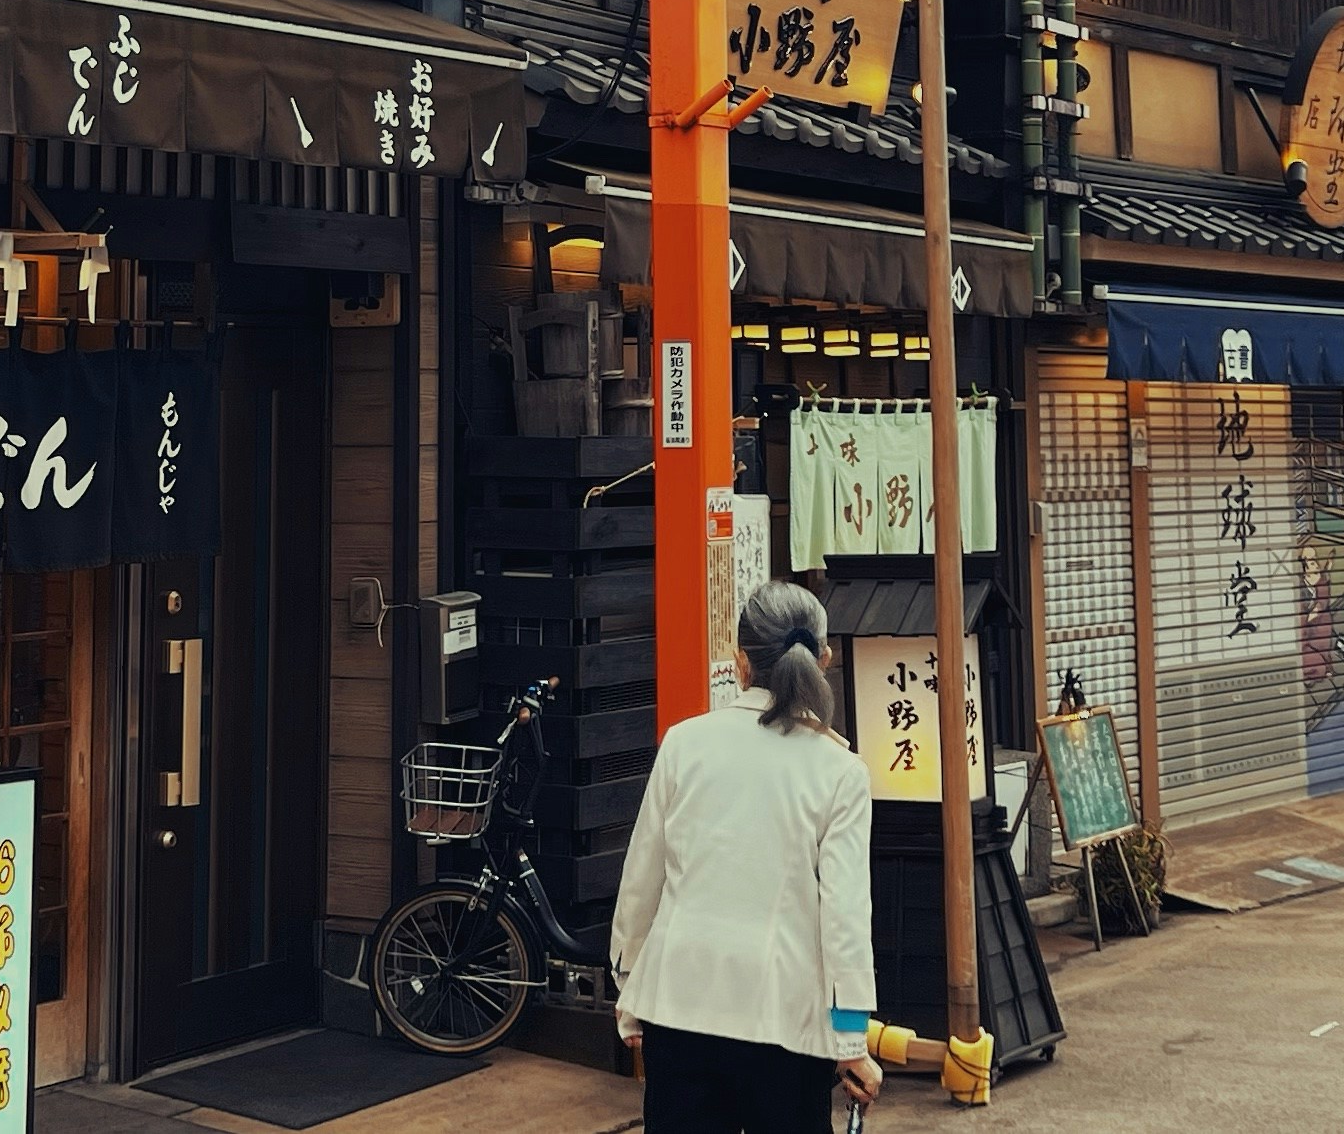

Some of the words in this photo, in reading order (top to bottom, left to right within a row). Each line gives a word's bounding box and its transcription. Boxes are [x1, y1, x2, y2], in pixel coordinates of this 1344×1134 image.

[109, 14, 141, 104] ふじ
[729, 3, 861, 88] 小野屋
[67, 46, 97, 136] でん
[373, 90, 399, 164] 焼き
[409, 58, 435, 169] お好み
[670, 346, 684, 433] 防犯カメラ作動中
[157, 391, 181, 515] もんじゃ
[843, 473, 934, 536] 小野
[1217, 390, 1258, 639] 地球堂
[886, 661, 920, 773] 小野屋
